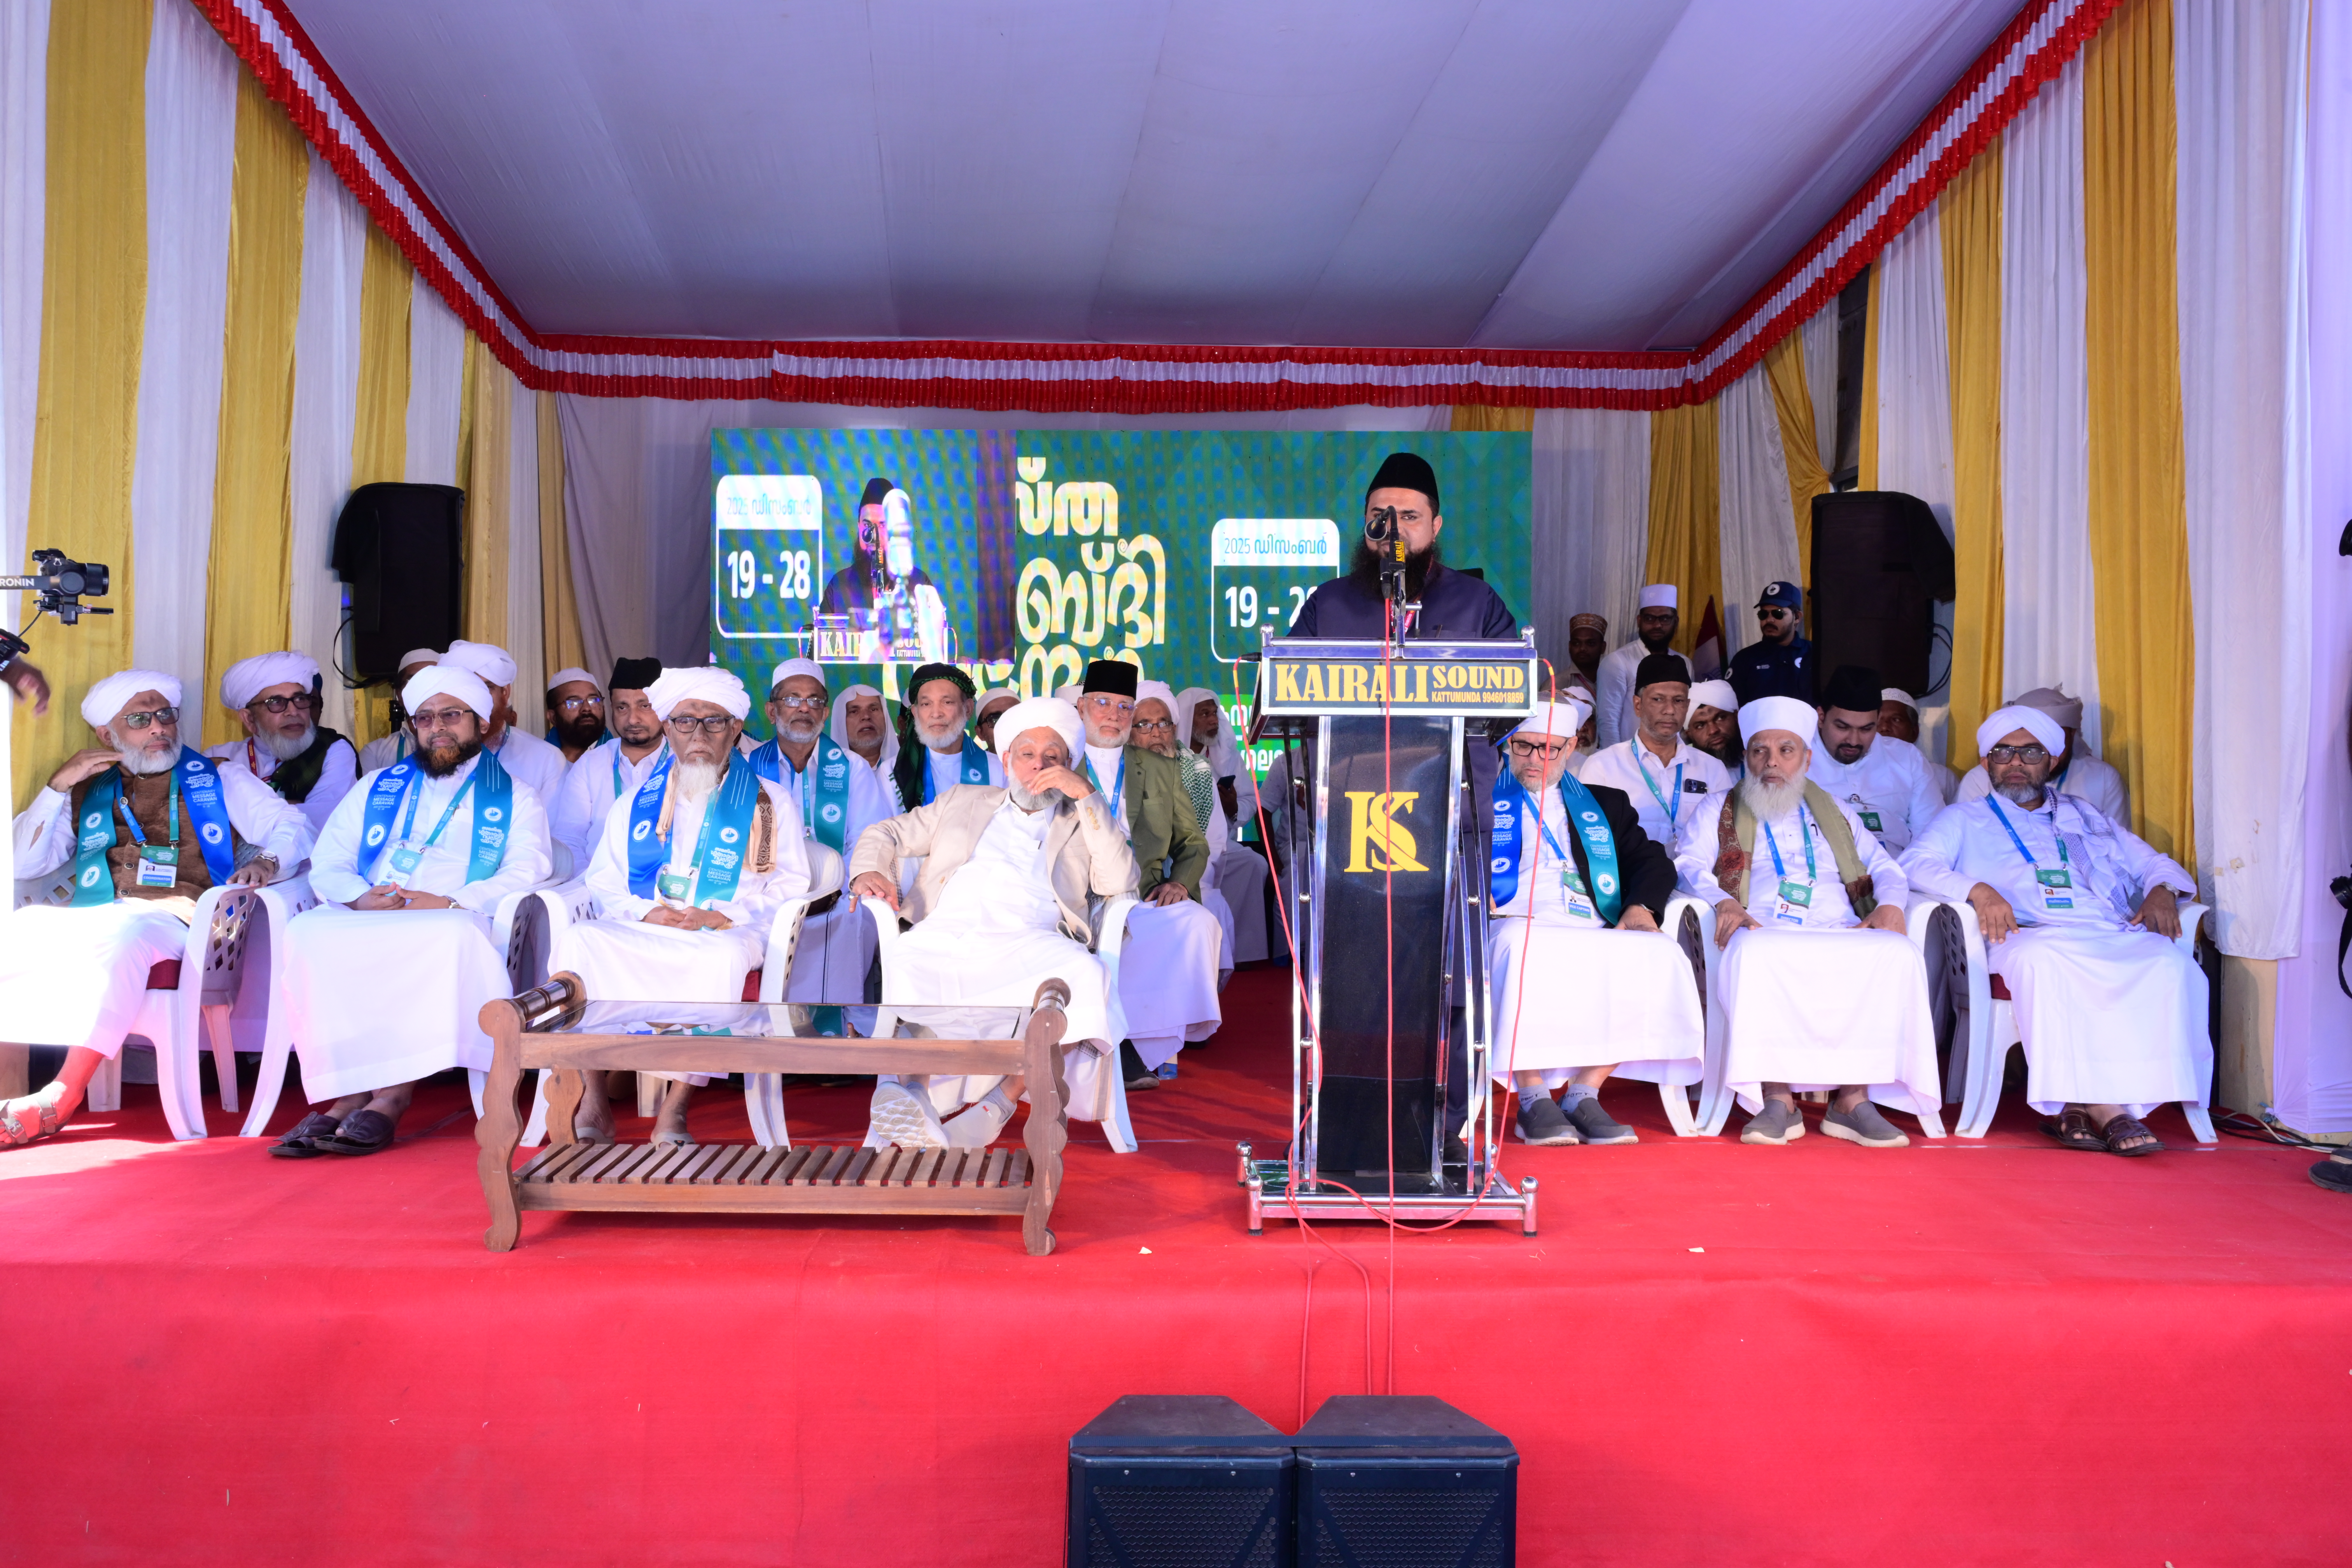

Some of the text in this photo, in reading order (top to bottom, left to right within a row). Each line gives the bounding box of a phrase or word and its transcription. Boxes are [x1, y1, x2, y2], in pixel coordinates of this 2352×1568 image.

[1225, 534, 1326, 554] 2025 ഡിസംബർ
[0, 578, 34, 586] RONIN
[728, 550, 810, 599] 19 - 28
[1225, 586, 1258, 628] 19
[1289, 586, 1318, 627] 2
[1275, 664, 1524, 702] KAIRALI SOUND
[1432, 691, 1524, 703] KATTUMUNDA 9946018859
[478, 854, 496, 862] CARAVAN
[479, 850, 497, 859] MESSAGE
